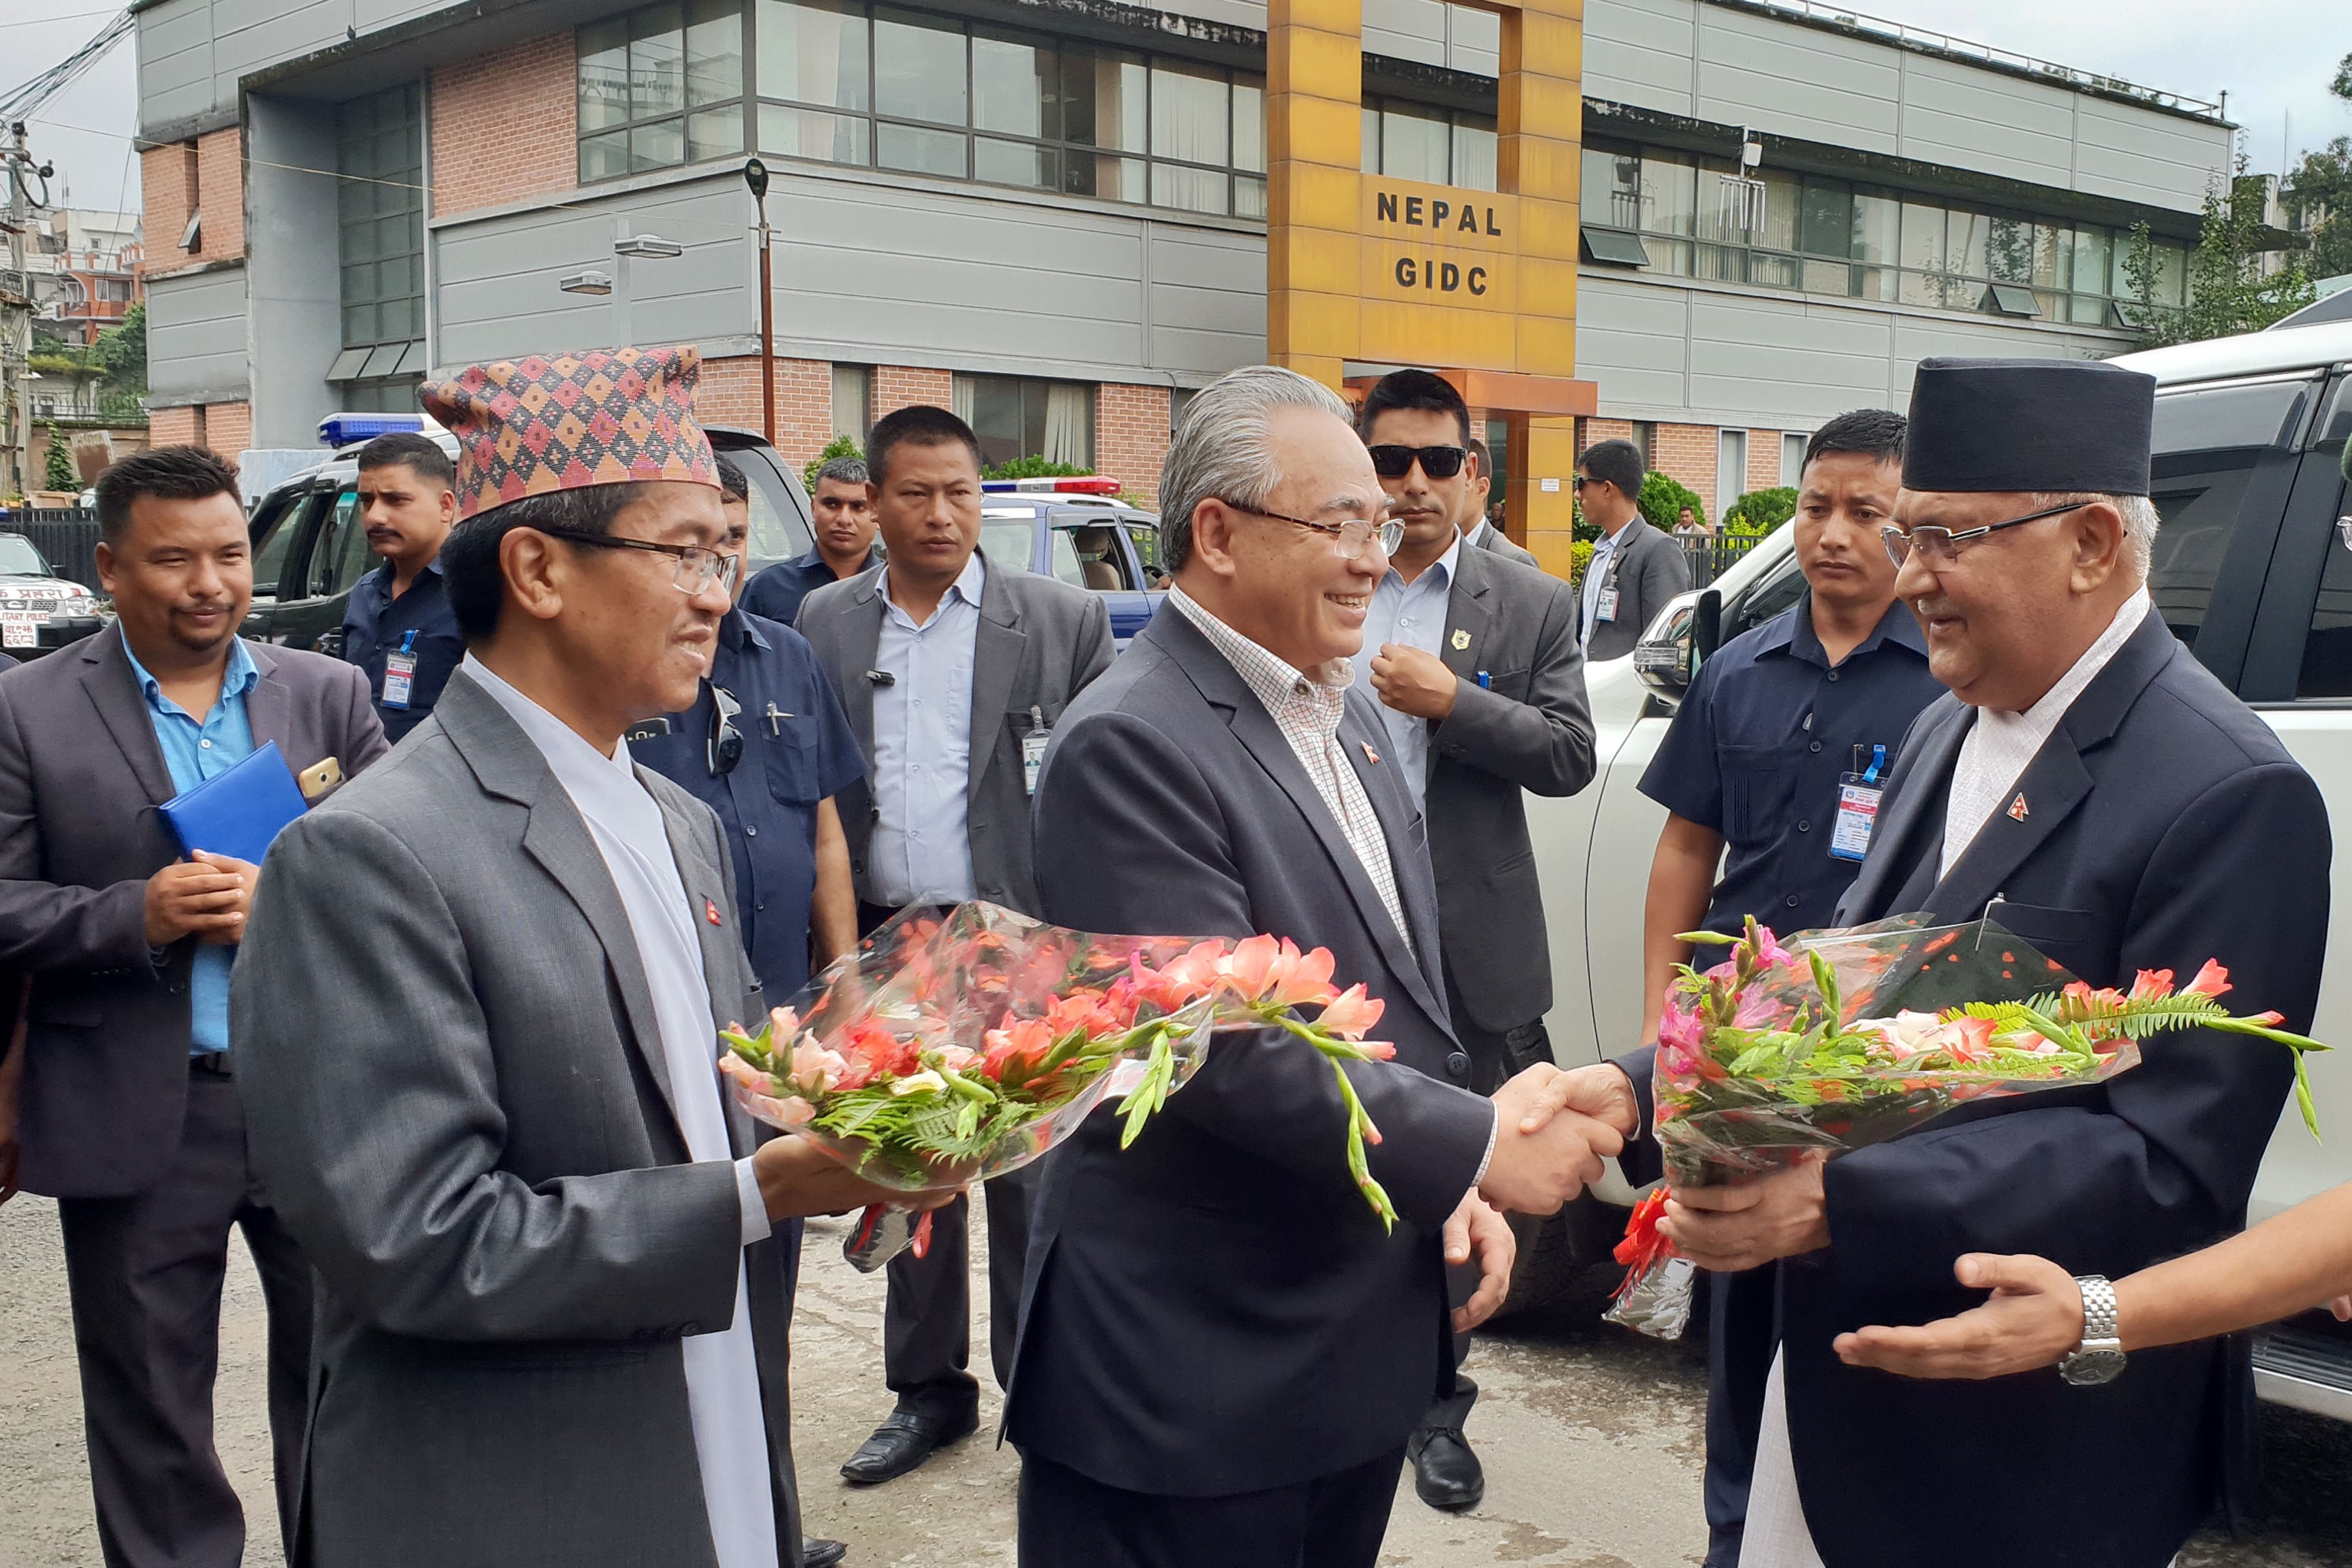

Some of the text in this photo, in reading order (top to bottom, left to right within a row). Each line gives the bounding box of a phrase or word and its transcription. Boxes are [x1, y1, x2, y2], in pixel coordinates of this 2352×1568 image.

[1378, 192, 1501, 237] NEPAL
[1396, 257, 1487, 296] GIDC
[27, 613, 49, 621] POLICE
